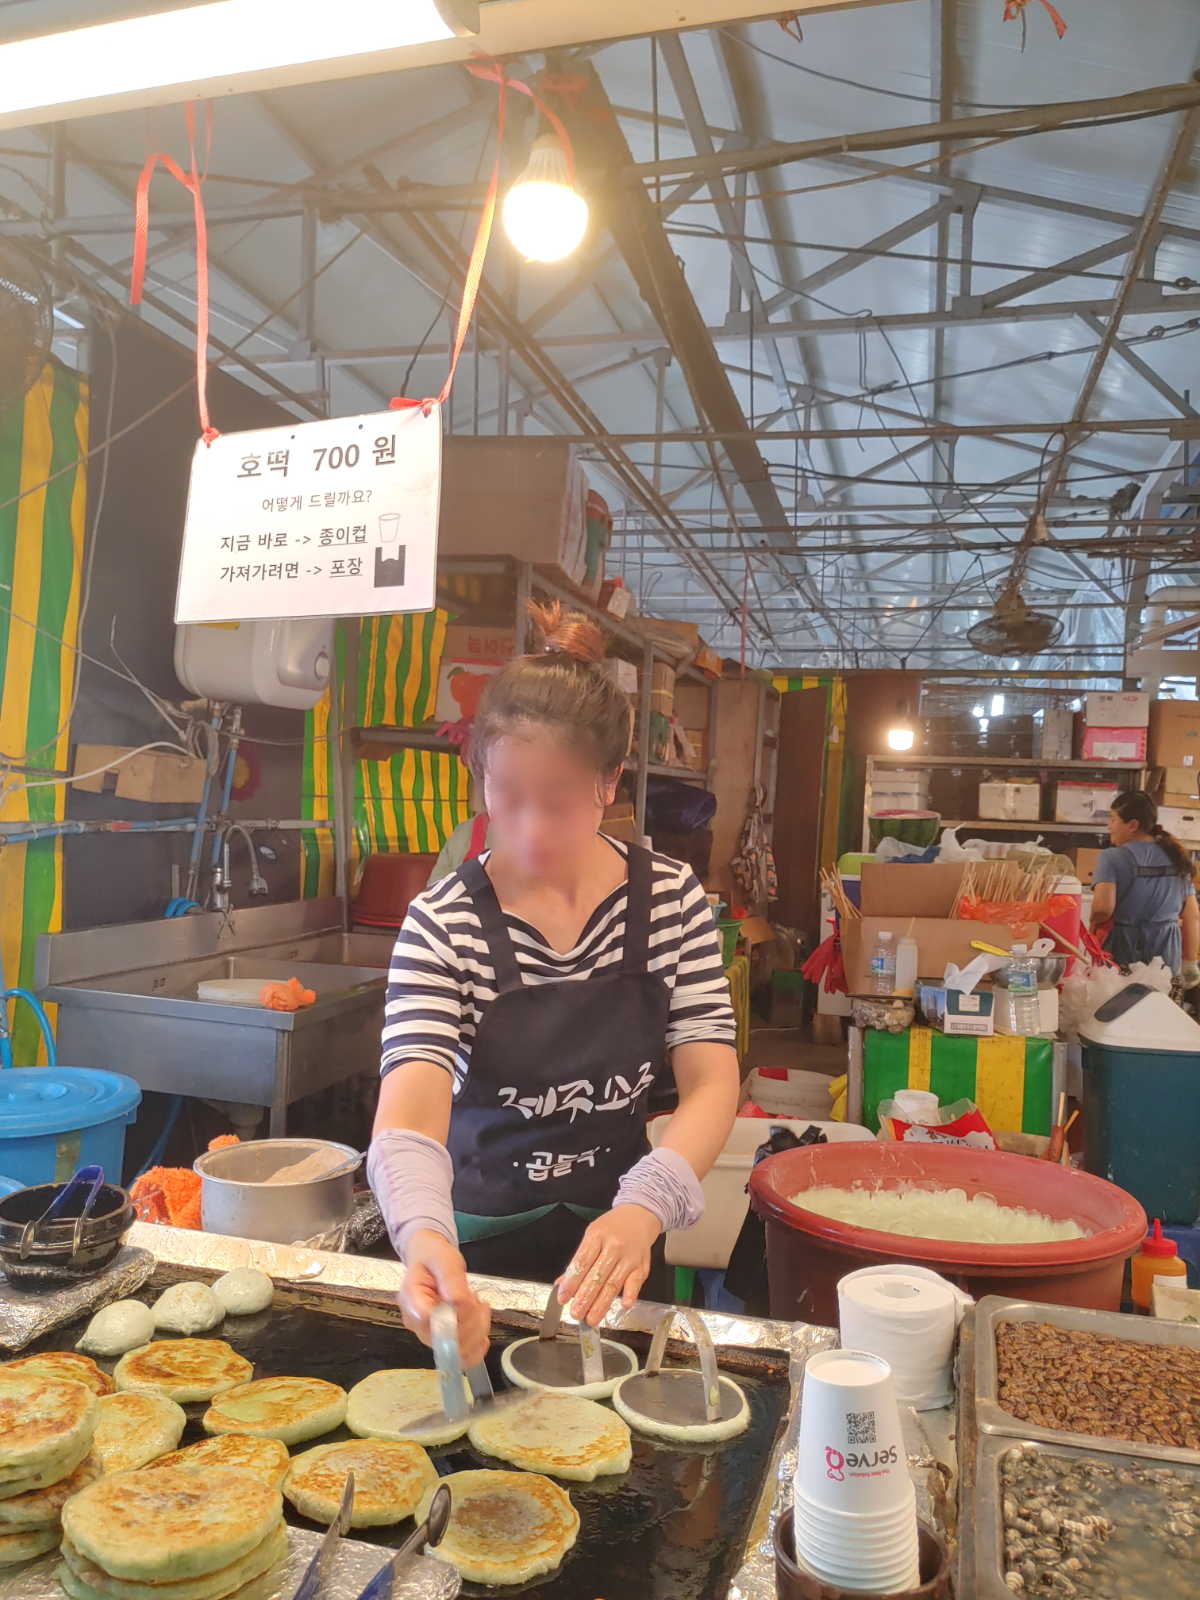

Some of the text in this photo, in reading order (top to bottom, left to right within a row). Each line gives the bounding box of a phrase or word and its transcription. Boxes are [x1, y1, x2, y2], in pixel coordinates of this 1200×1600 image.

[236, 434, 396, 479] 호떡 700 원
[261, 489, 373, 513] 어떻게 드릴까요?
[220, 534, 251, 552] 지금
[257, 532, 288, 550] 바로
[318, 524, 368, 547] 종이컵
[220, 561, 299, 583] 가져가려면
[329, 557, 363, 577] 포장
